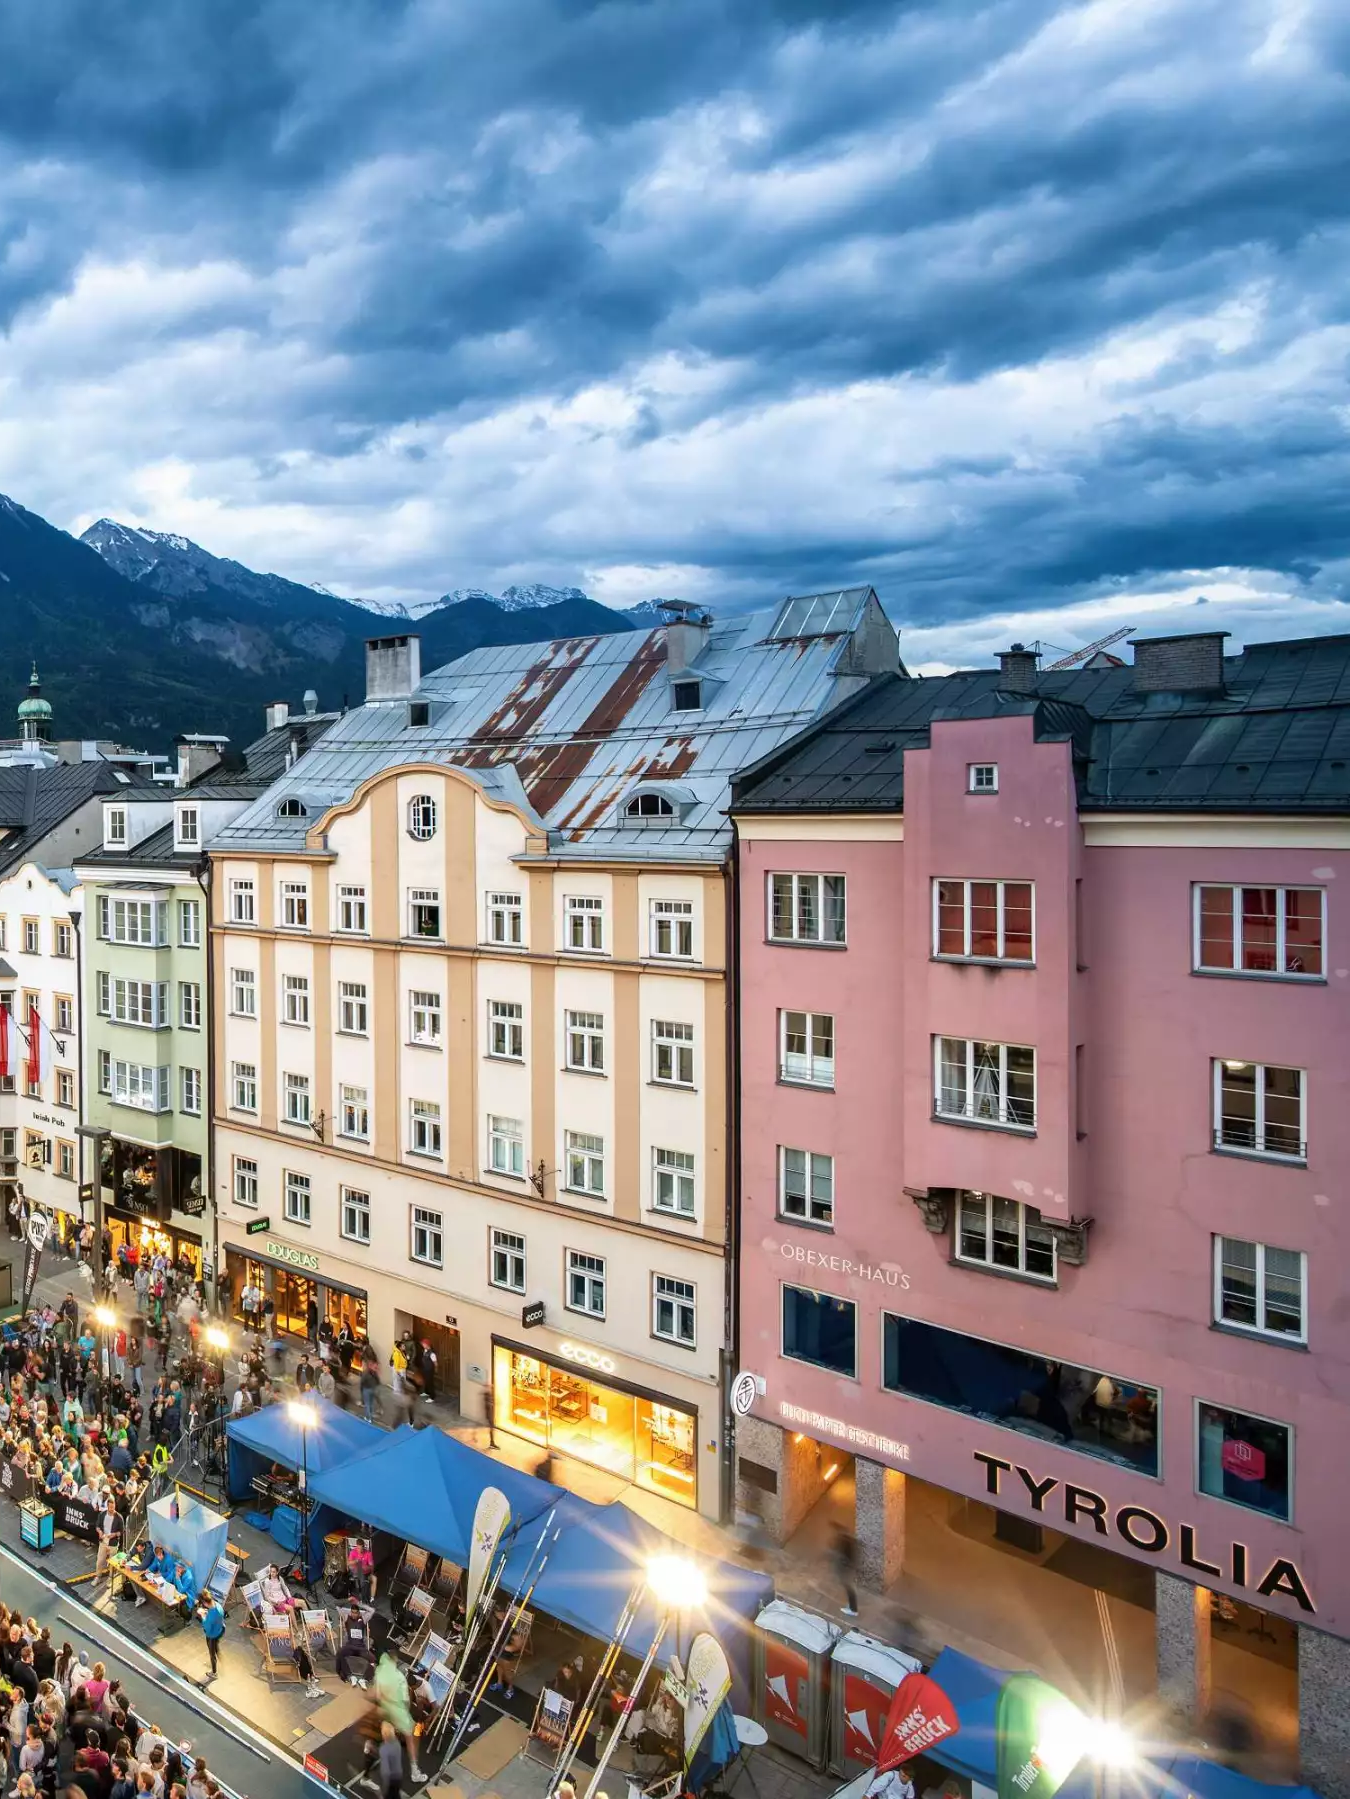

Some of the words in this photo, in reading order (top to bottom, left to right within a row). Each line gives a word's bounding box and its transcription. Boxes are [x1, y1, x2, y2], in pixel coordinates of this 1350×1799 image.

[33, 1112, 50, 1122] Irish
[52, 1117, 65, 1127] Pub
[267, 1241, 319, 1269] DOUGLAS
[781, 1243, 911, 1290] OBEXER-HAUS
[526, 1310, 543, 1322] ecco
[560, 1342, 615, 1373] ecco
[65, 1514, 90, 1530] BRUCK
[66, 1506, 85, 1519] INNS'
[974, 1451, 1317, 1613] TYROLIA
[894, 1704, 926, 1741] INNS'
[904, 1715, 952, 1752] BRUCK
